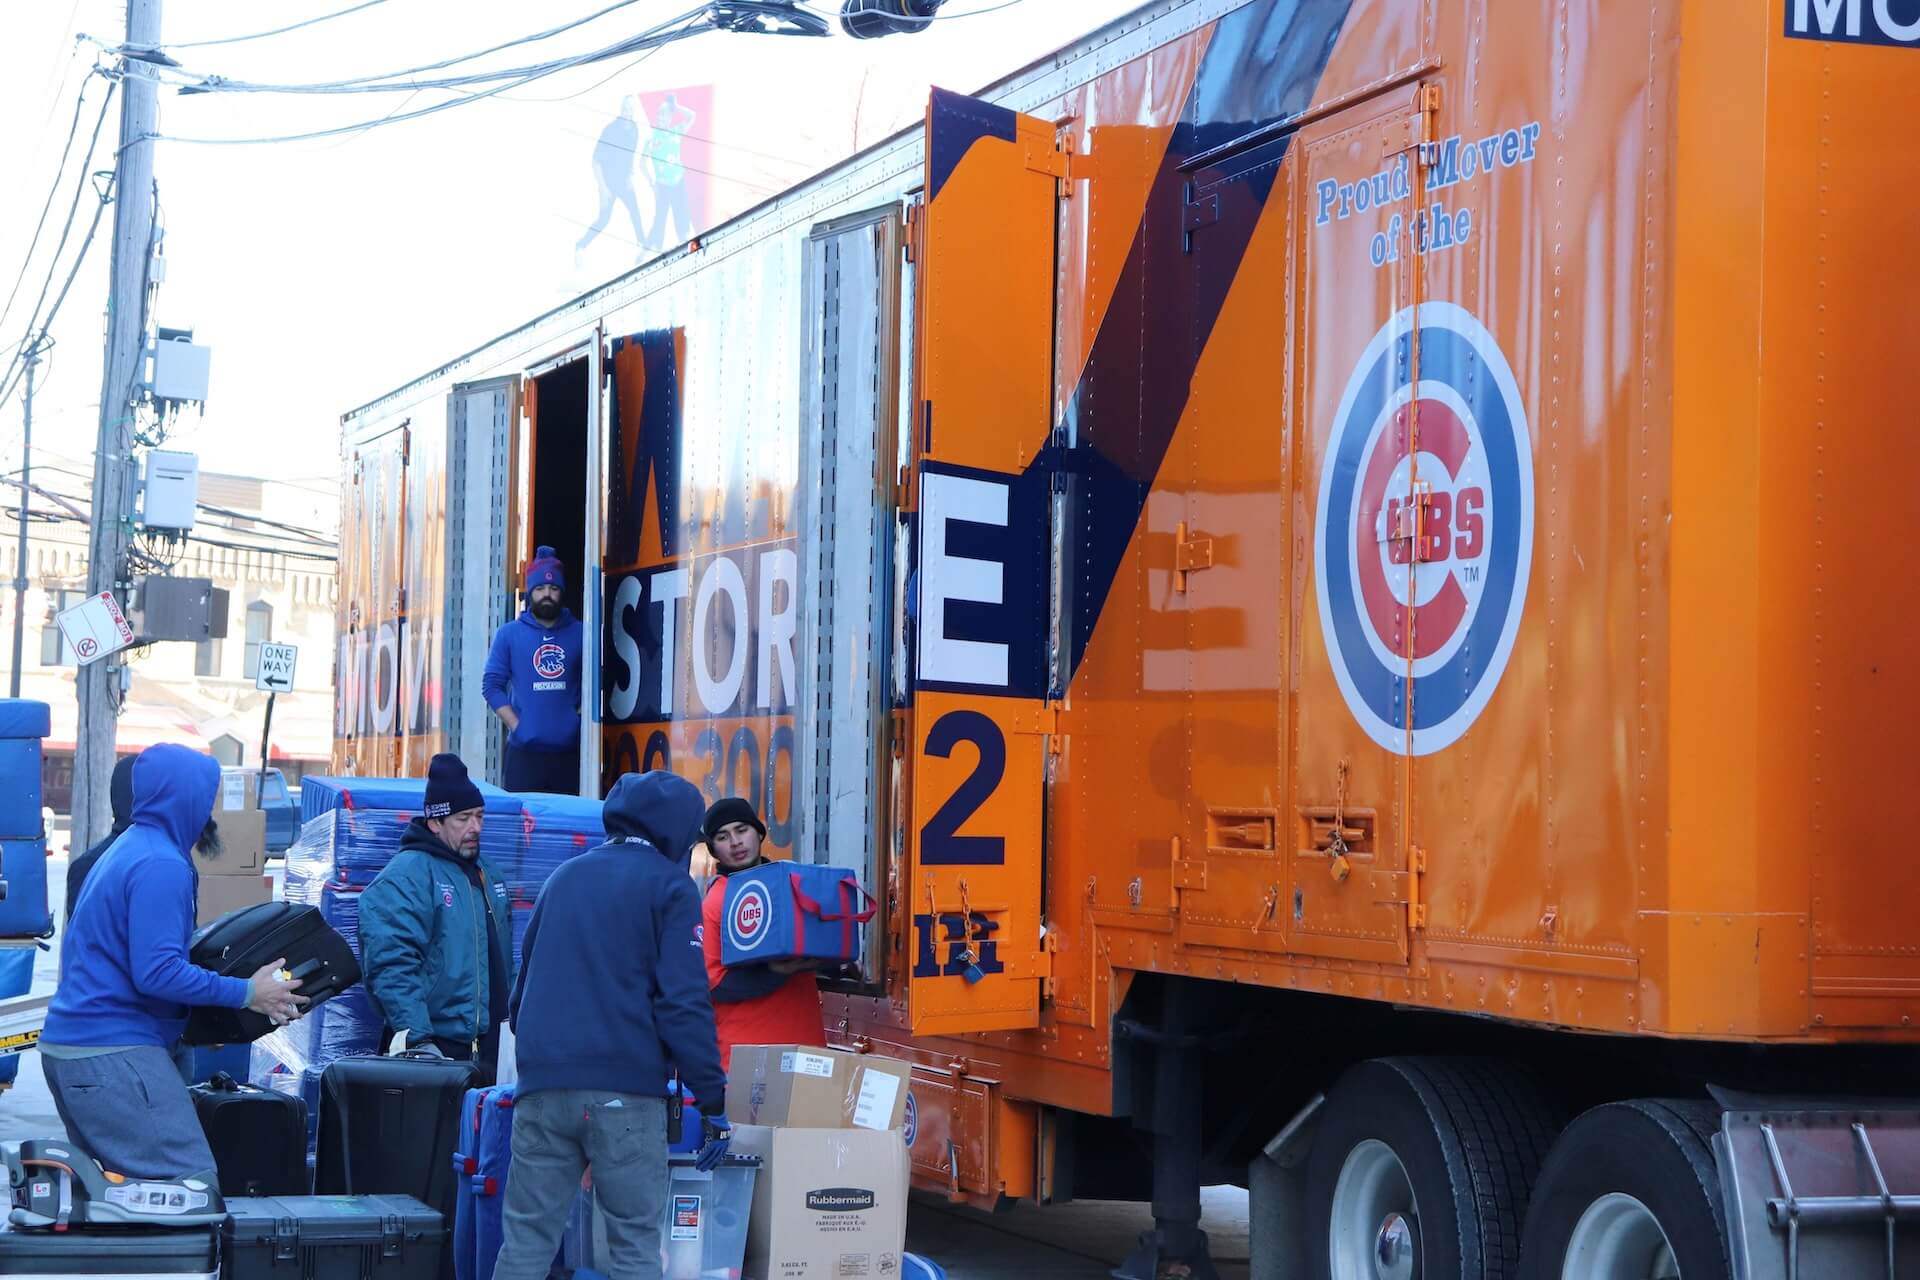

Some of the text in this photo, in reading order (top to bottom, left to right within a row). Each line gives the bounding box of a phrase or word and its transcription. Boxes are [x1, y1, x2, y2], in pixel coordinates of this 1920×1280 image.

[1316, 121, 1541, 226] Proud Mover
[1370, 201, 1472, 267] of the
[919, 472, 1009, 687] E
[1463, 566, 1479, 583] TM
[265, 646, 292, 660] ONE
[608, 548, 798, 720] STOR
[263, 660, 291, 673] WAY
[920, 709, 1007, 865] 2
[737, 895, 761, 934] CUBS
[809, 1196, 871, 1204] Rubbermaid
